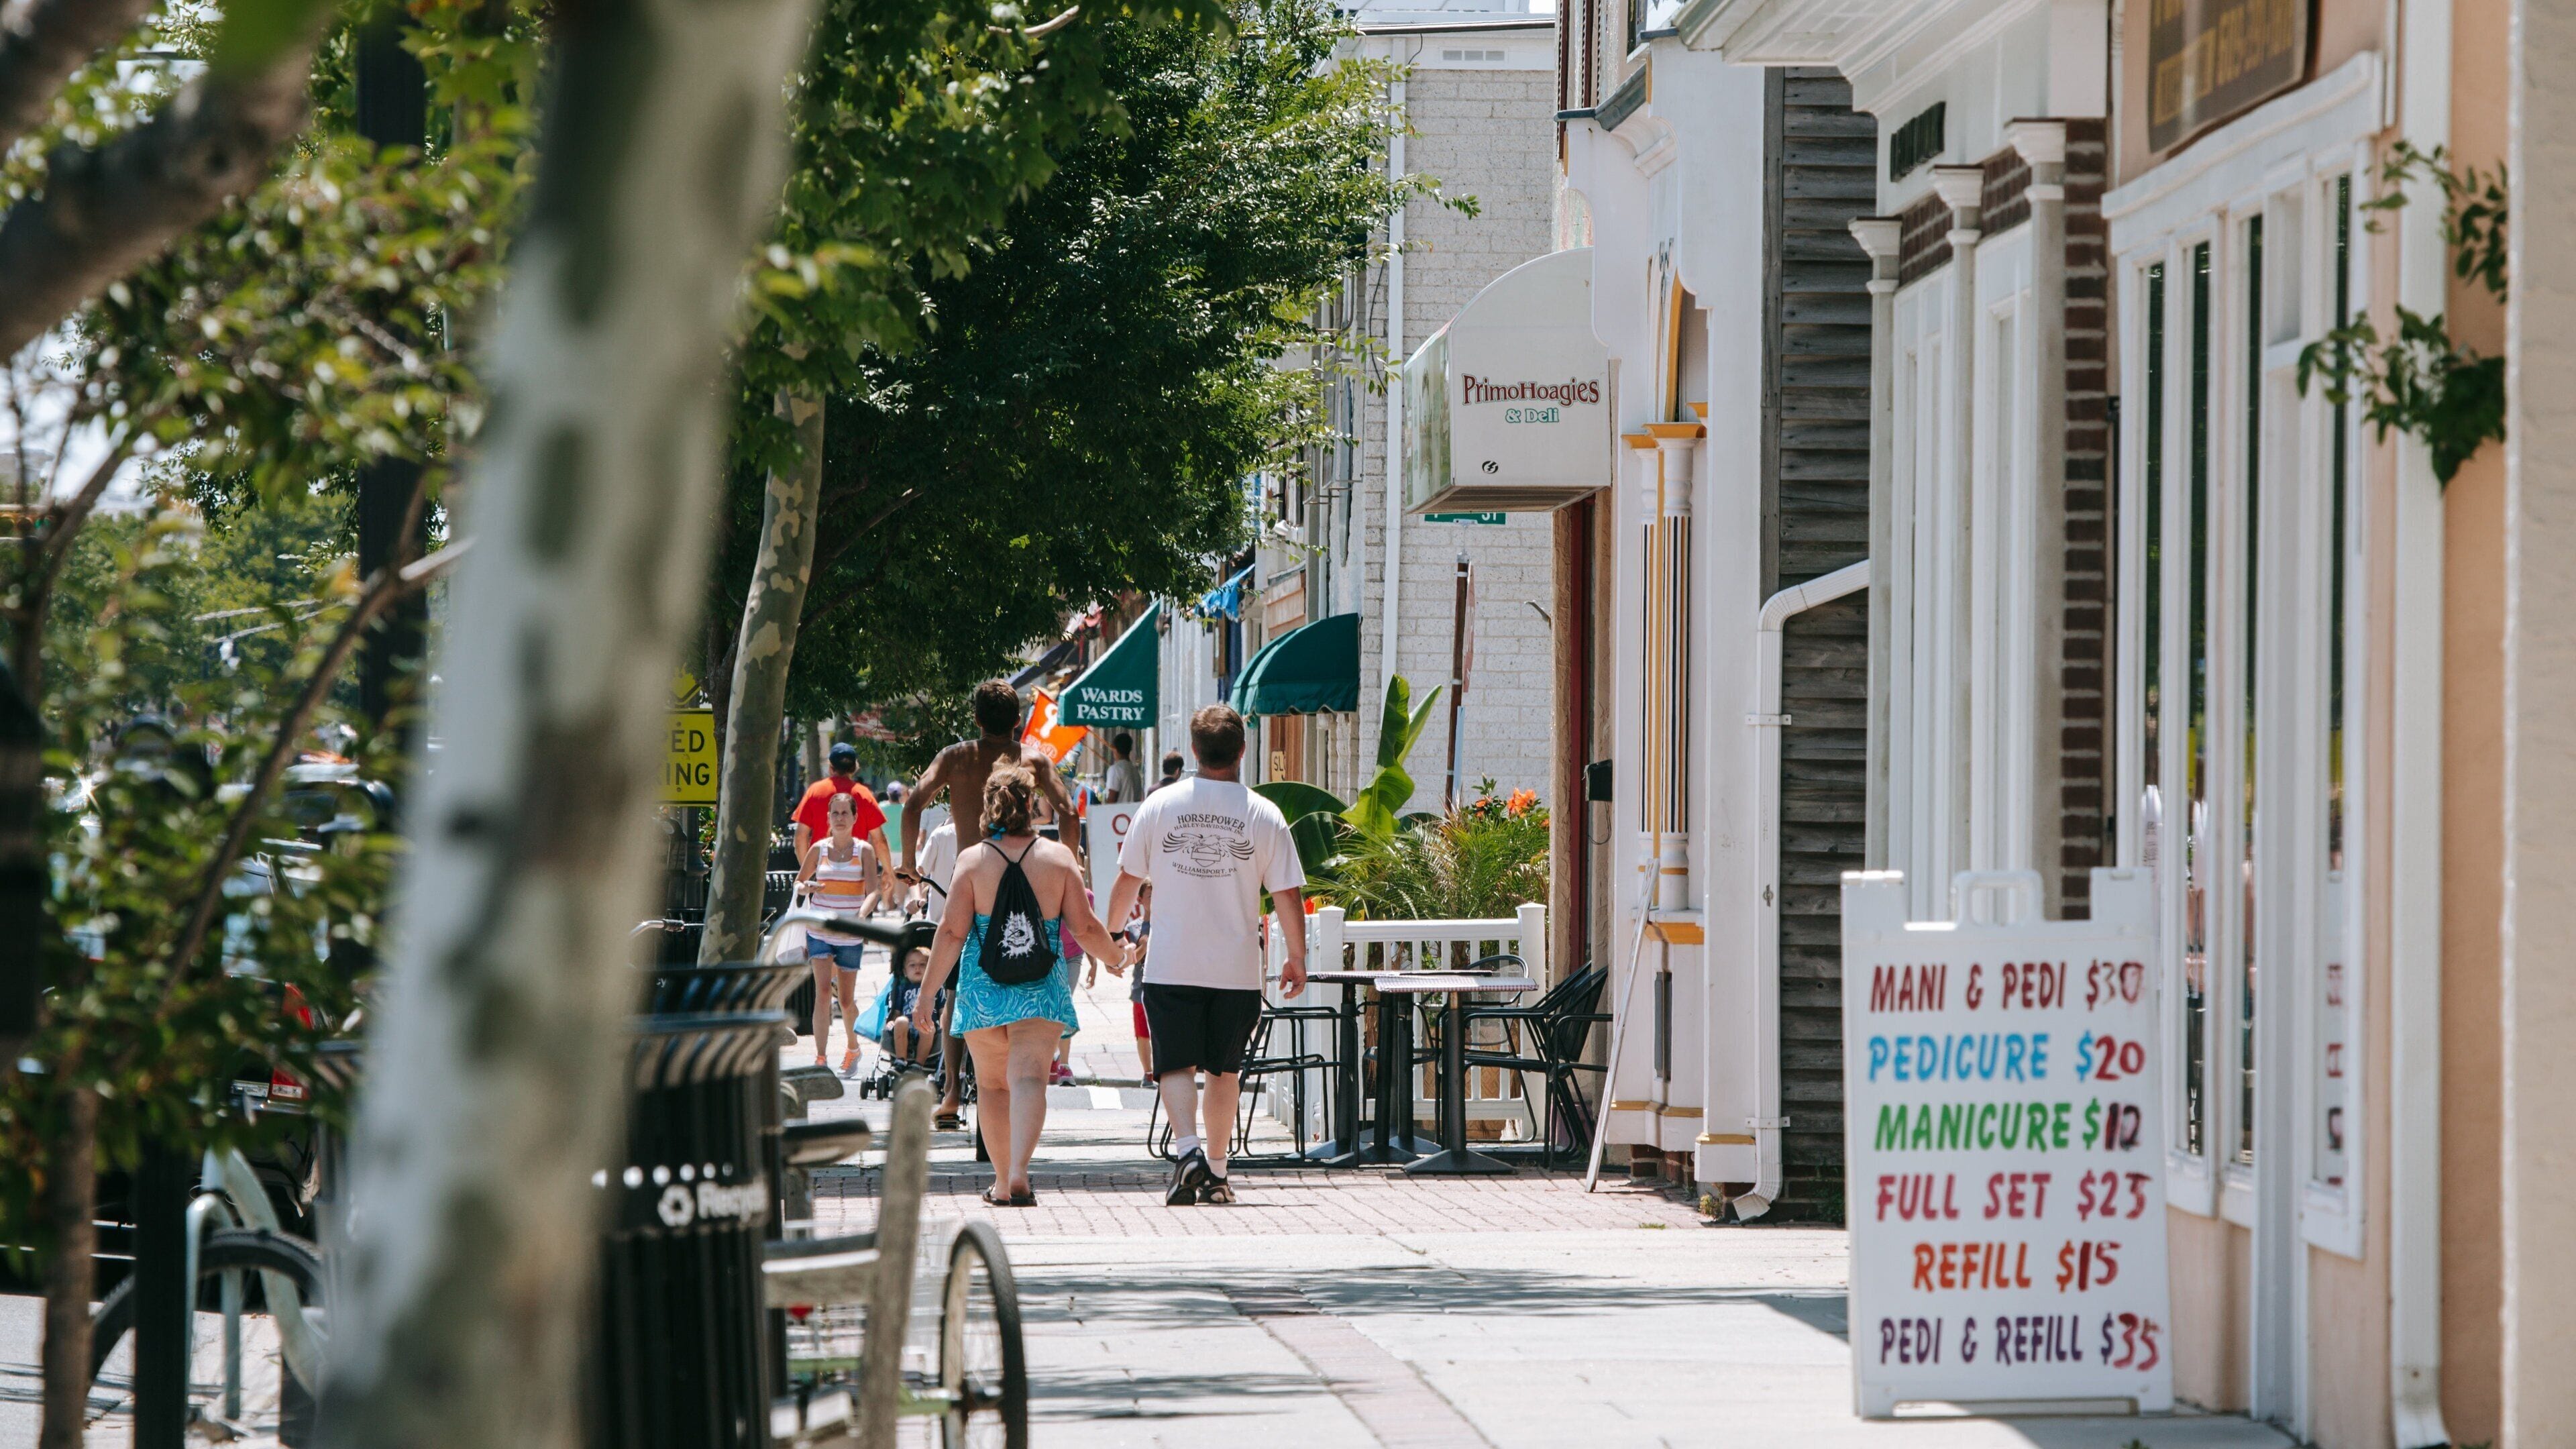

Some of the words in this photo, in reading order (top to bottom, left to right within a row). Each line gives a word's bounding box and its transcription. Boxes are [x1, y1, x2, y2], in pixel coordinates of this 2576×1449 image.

[1462, 374, 1600, 407] PrimoHoagies
[1506, 409, 1521, 423] &
[1525, 408, 1560, 423] Deli
[1077, 704, 1145, 720] PASTRY
[1081, 688, 1143, 703] WARDS
[672, 730, 705, 753] ED
[665, 763, 710, 786] ING
[1177, 814, 1245, 830] HORSEPOWER
[1870, 964, 1946, 1012] MANI
[1966, 964, 1983, 1010] &
[2002, 962, 2066, 1009] PEDI
[1868, 1032, 2049, 1083] PEDICURE
[2075, 1030, 2145, 1083] $20
[1874, 1102, 2072, 1152] MANICURE
[1876, 1173, 1959, 1222] FULL
[1984, 1173, 2051, 1220] SET
[1913, 1242, 2032, 1293] REFILL
[2055, 1240, 2121, 1293] $15
[1880, 1318, 1943, 1364] PEDI
[1962, 1318, 1977, 1362] &
[1996, 1315, 2083, 1366] REFILL
[2100, 1312, 2159, 1372] $35
